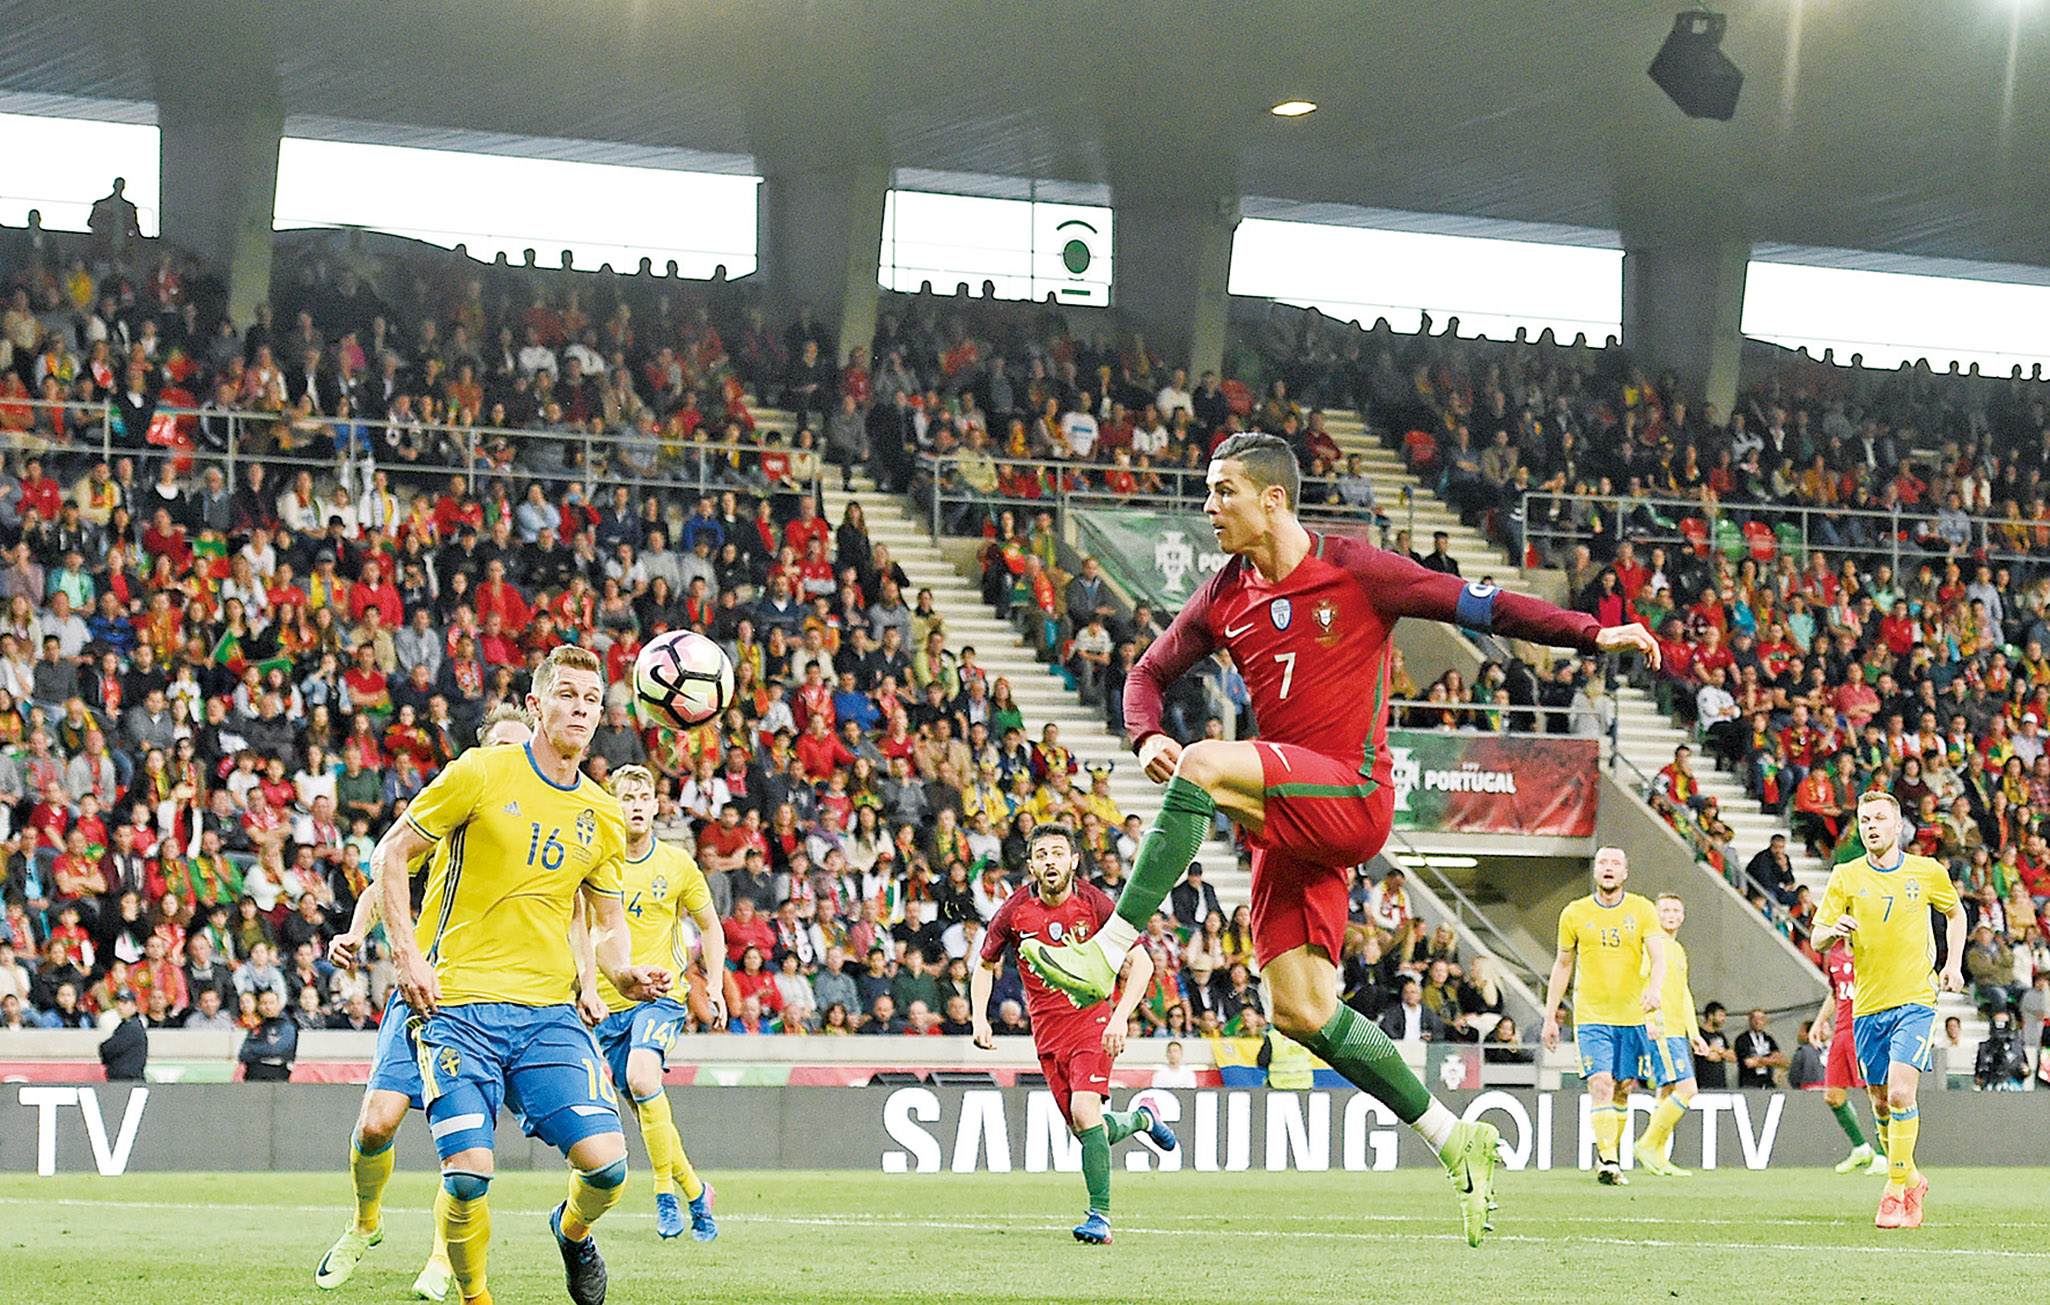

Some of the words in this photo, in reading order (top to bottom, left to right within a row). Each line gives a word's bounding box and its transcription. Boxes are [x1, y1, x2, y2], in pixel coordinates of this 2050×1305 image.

[1274, 652, 1296, 699] 7
[1424, 769, 1517, 794] PORTUGAL
[527, 822, 565, 870] 16
[1881, 896, 1893, 922] 7
[1600, 928, 1621, 948] 13
[642, 1019, 670, 1047] 14
[1912, 1035, 1926, 1062] 7
[1638, 1055, 1652, 1077] 13
[19, 1087, 149, 1176] TV
[1690, 1093, 1785, 1171] TV
